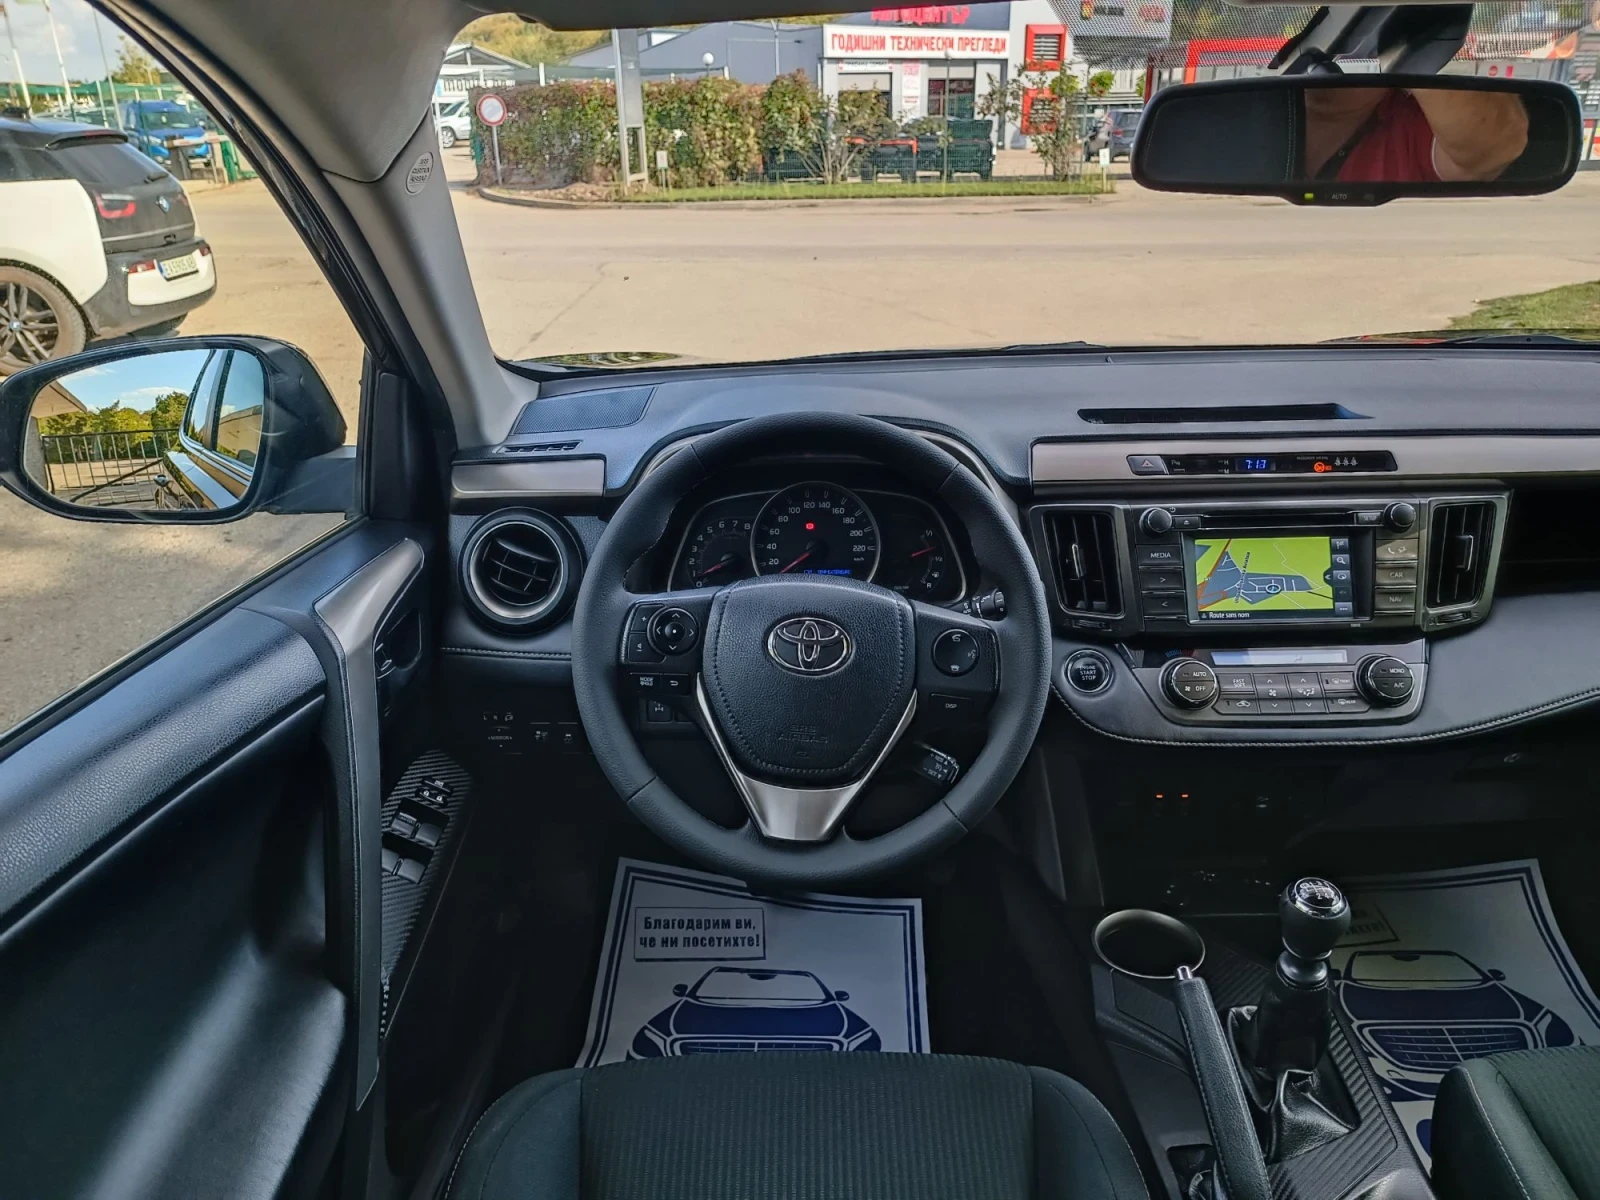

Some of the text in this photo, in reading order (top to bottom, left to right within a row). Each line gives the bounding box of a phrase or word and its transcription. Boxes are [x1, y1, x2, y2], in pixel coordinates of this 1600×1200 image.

[831, 34, 1006, 53] ГОДИШНИ ТЕХНИЧЕСКИ ПРЕГЛЕДИ
[803, 501, 816, 509] 120
[818, 501, 831, 509] 140
[778, 515, 789, 523] 80
[718, 521, 725, 529] 6
[732, 520, 738, 528] 7
[706, 526, 713, 534] 5
[643, 916, 757, 931] Благодарим ви,
[639, 933, 761, 948] че ни посетихте!
